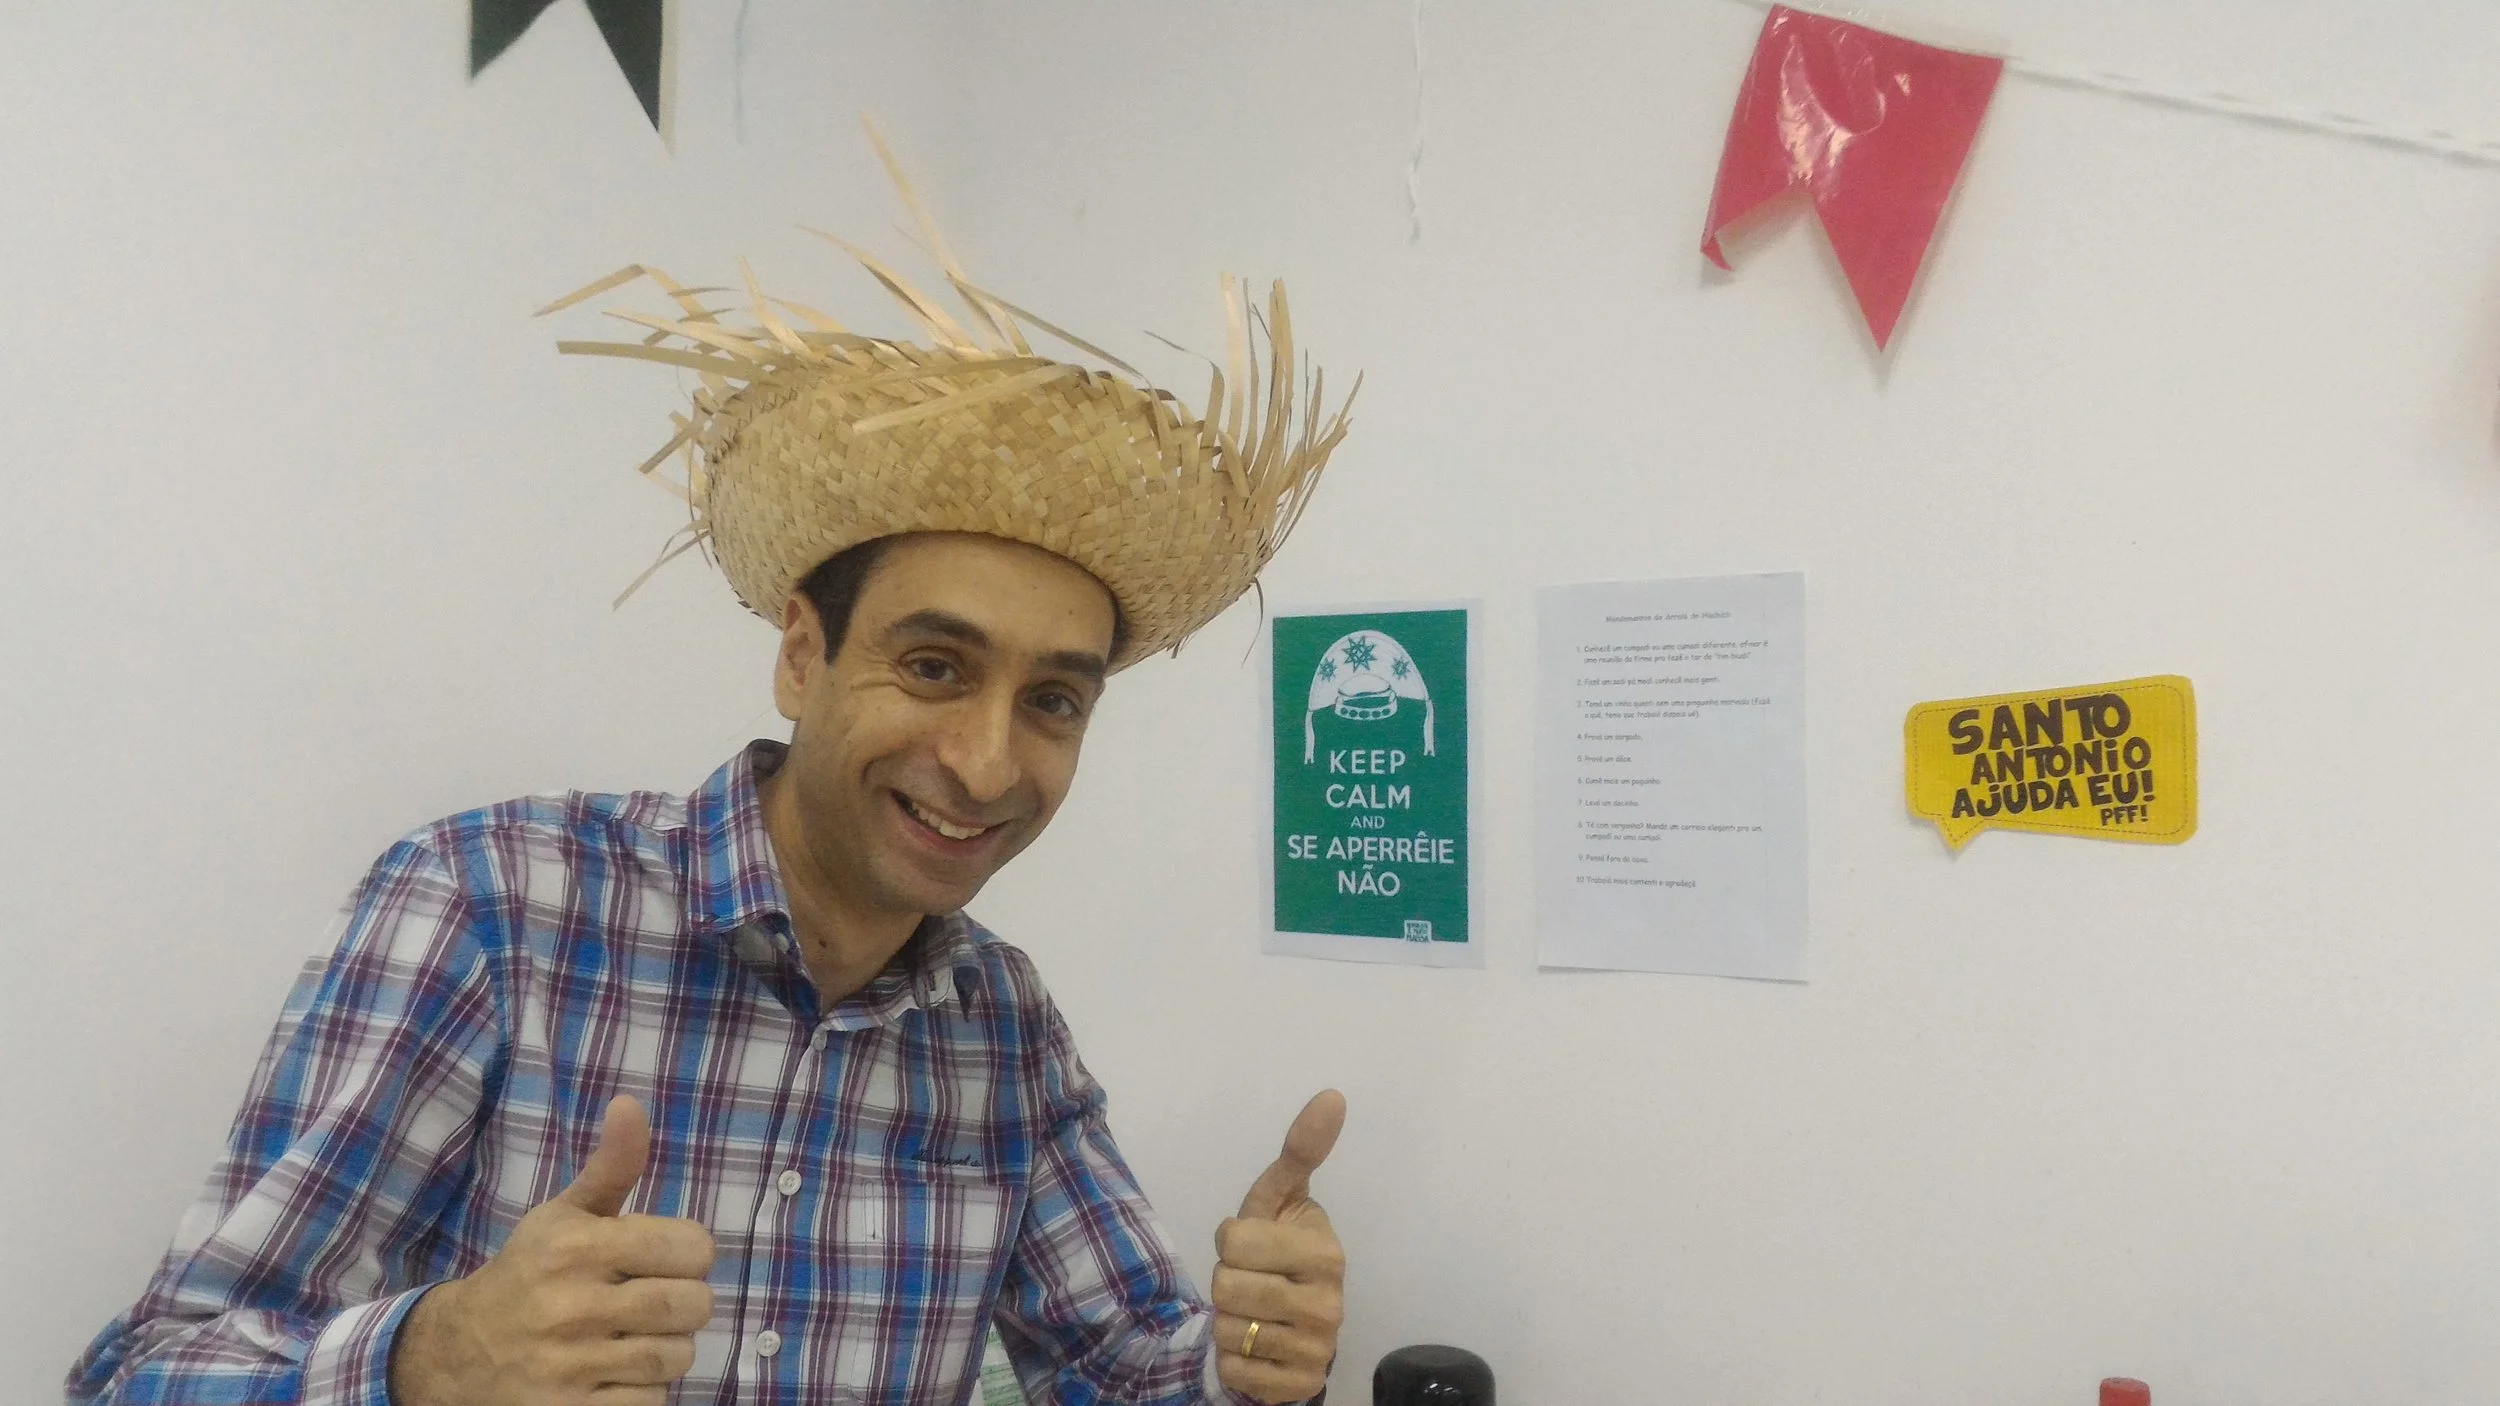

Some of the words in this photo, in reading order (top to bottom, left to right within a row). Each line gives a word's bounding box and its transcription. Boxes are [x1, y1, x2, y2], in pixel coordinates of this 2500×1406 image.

[1948, 693, 2131, 755] SANTO
[1330, 750, 1406, 774] KEEP
[1326, 784, 1411, 809] CALM
[2088, 770, 2155, 806] EU!
[1351, 816, 1385, 829] AND
[2101, 805, 2148, 826] PFF!
[1287, 834, 1318, 859] SE
[1327, 831, 1454, 864] APERRÊIE
[1338, 864, 1401, 897] NÃO
